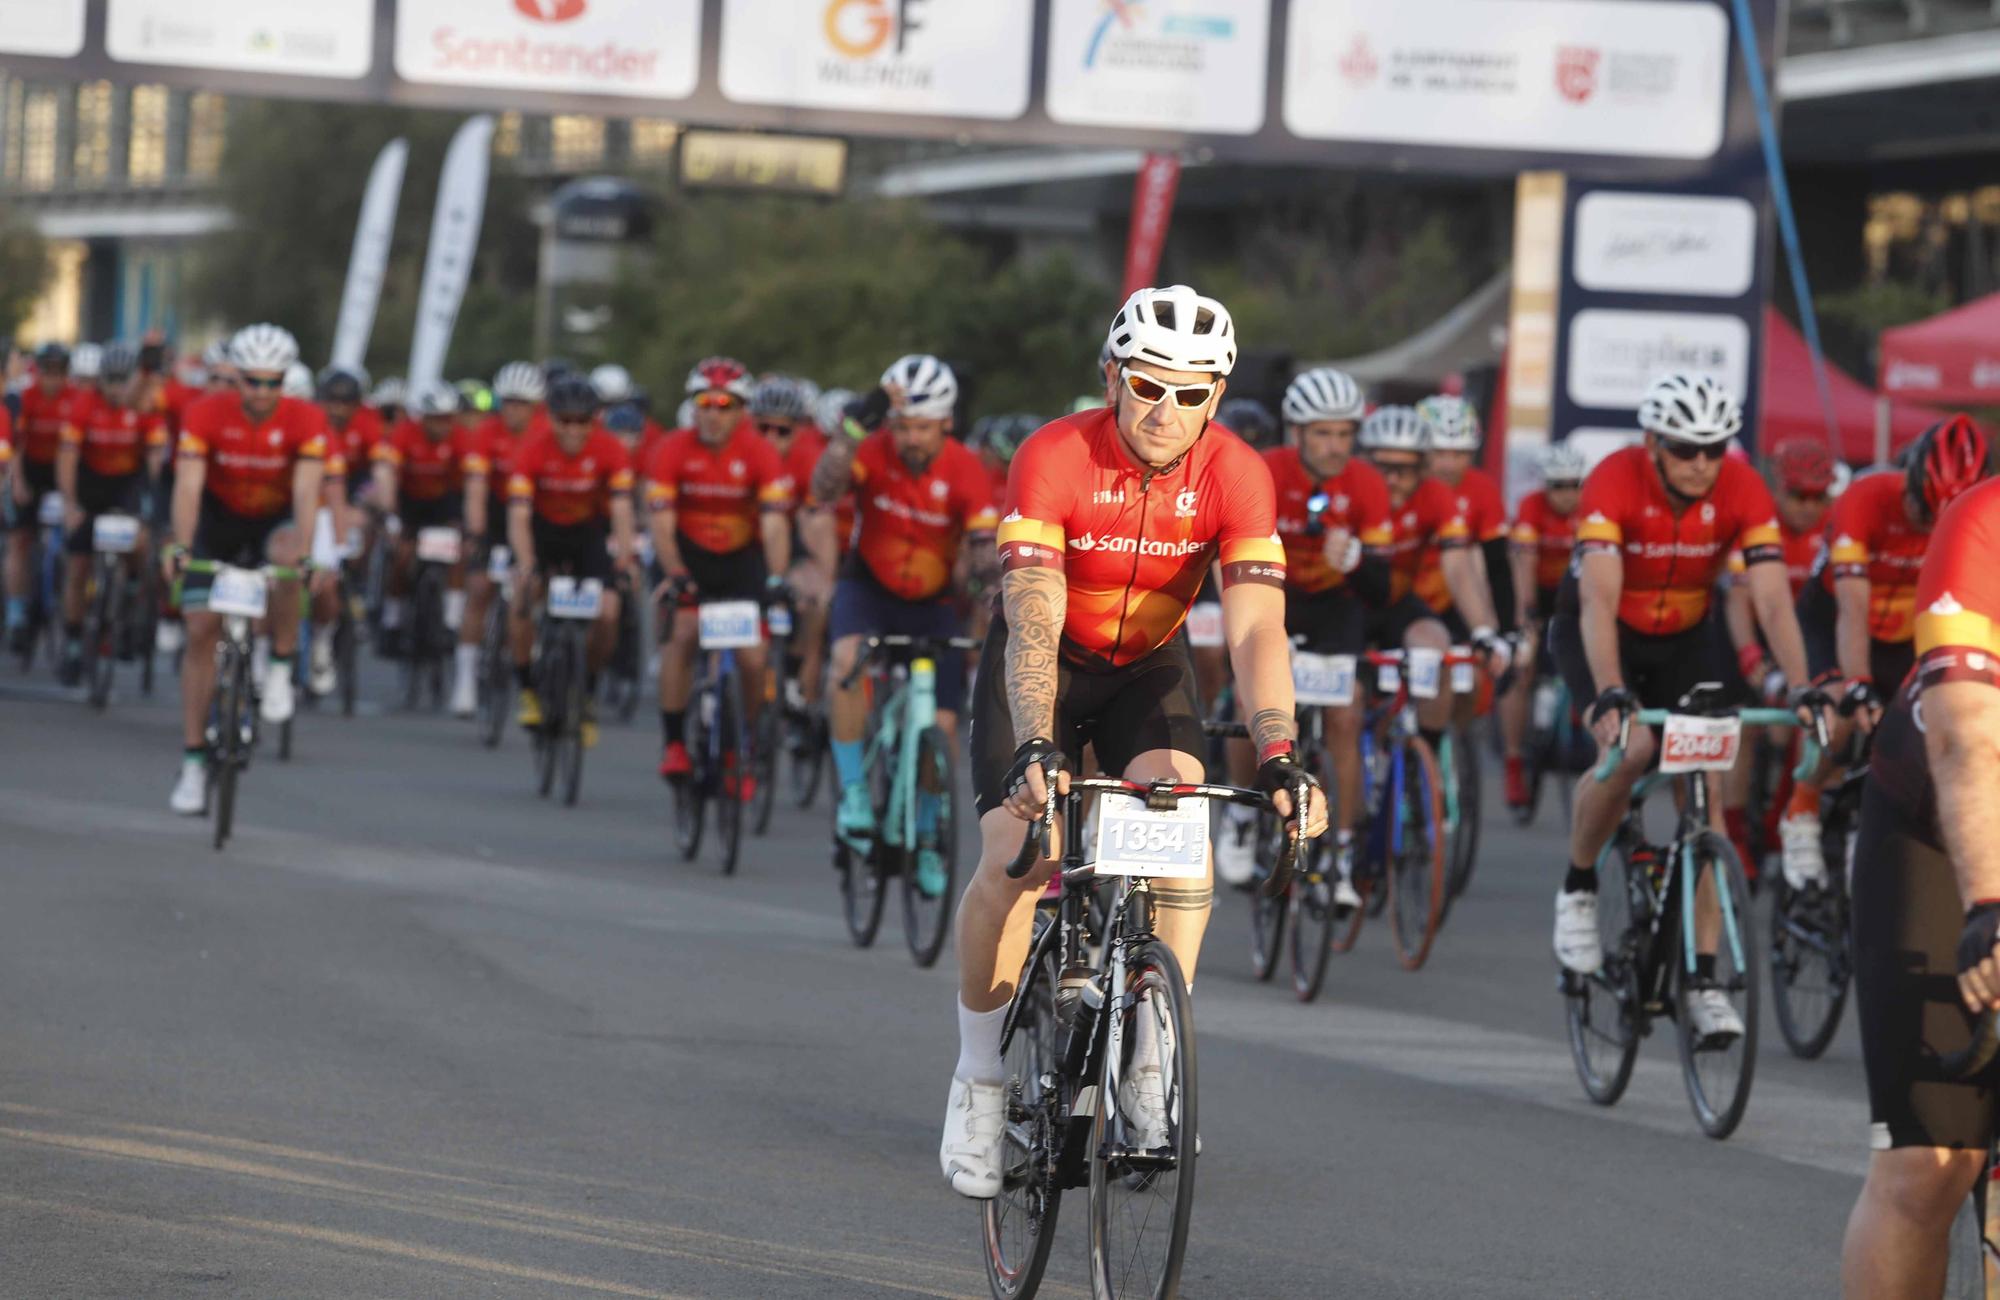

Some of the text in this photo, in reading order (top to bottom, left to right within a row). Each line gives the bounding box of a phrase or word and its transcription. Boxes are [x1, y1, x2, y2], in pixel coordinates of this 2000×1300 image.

[432, 26, 658, 80] Santander
[1094, 534, 1209, 557] Santander
[1109, 820, 1186, 853] 1354
